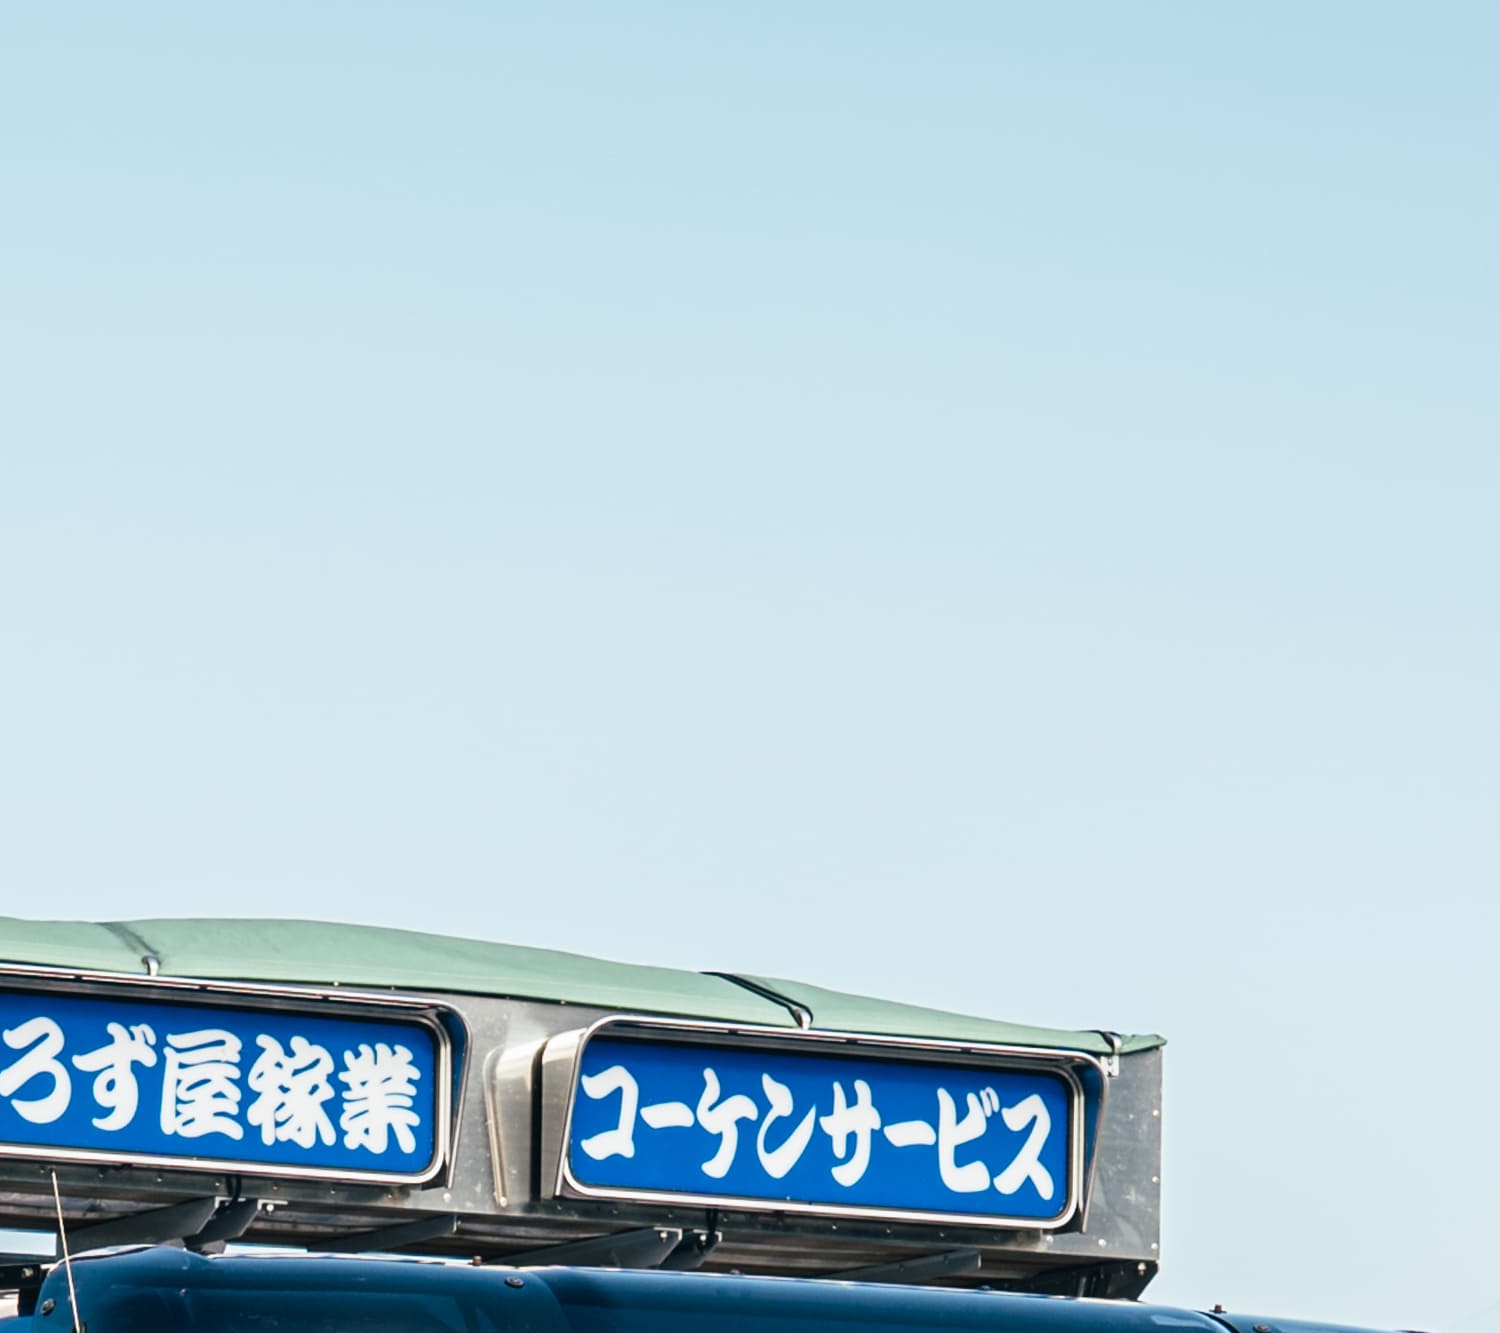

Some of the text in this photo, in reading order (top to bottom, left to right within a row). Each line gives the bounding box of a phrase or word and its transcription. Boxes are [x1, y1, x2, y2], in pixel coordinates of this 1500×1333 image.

[581, 1064, 1054, 1201] コーケンサービス
